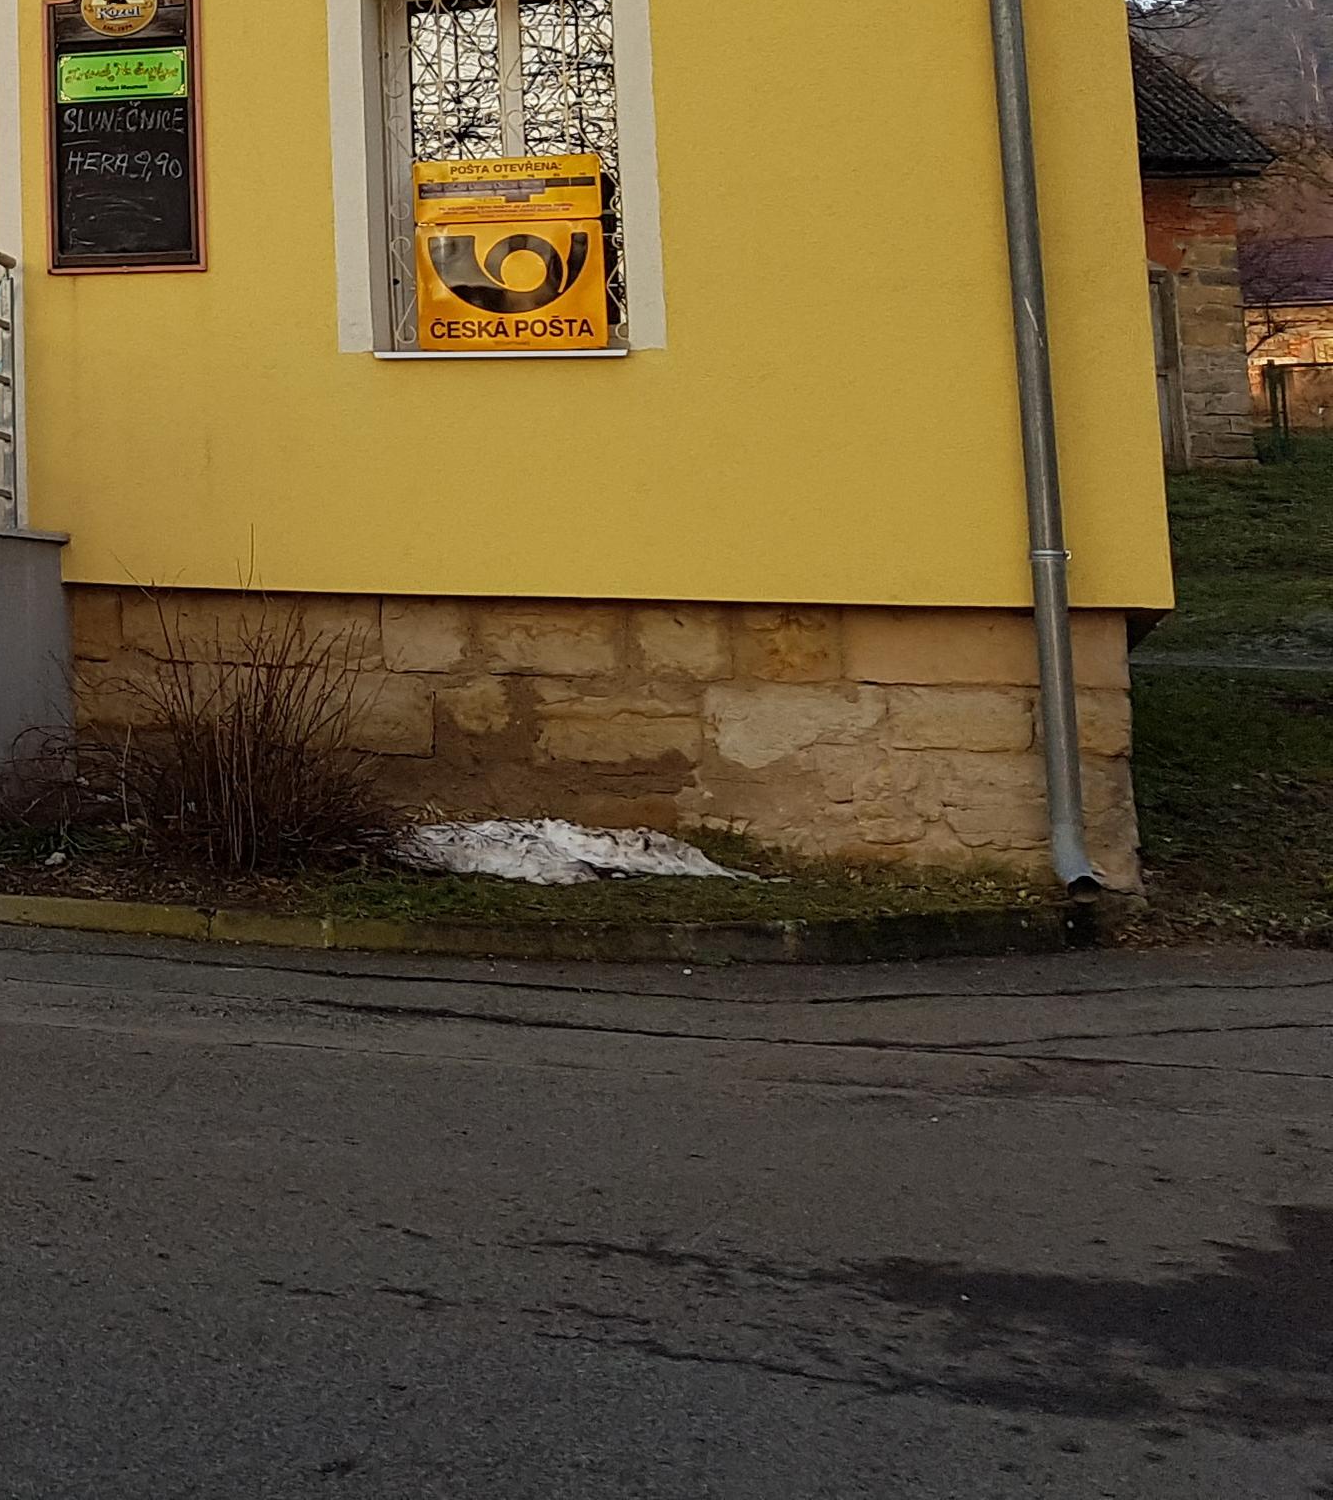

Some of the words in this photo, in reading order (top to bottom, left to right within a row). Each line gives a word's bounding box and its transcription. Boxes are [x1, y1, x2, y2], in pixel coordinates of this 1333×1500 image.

[68, 150, 128, 176] HERA
[450, 163, 489, 175] POŠTA
[493, 160, 562, 173] OTEVŘENA:
[430, 318, 509, 339] ČESKÁ
[515, 316, 594, 338] POŠTA
